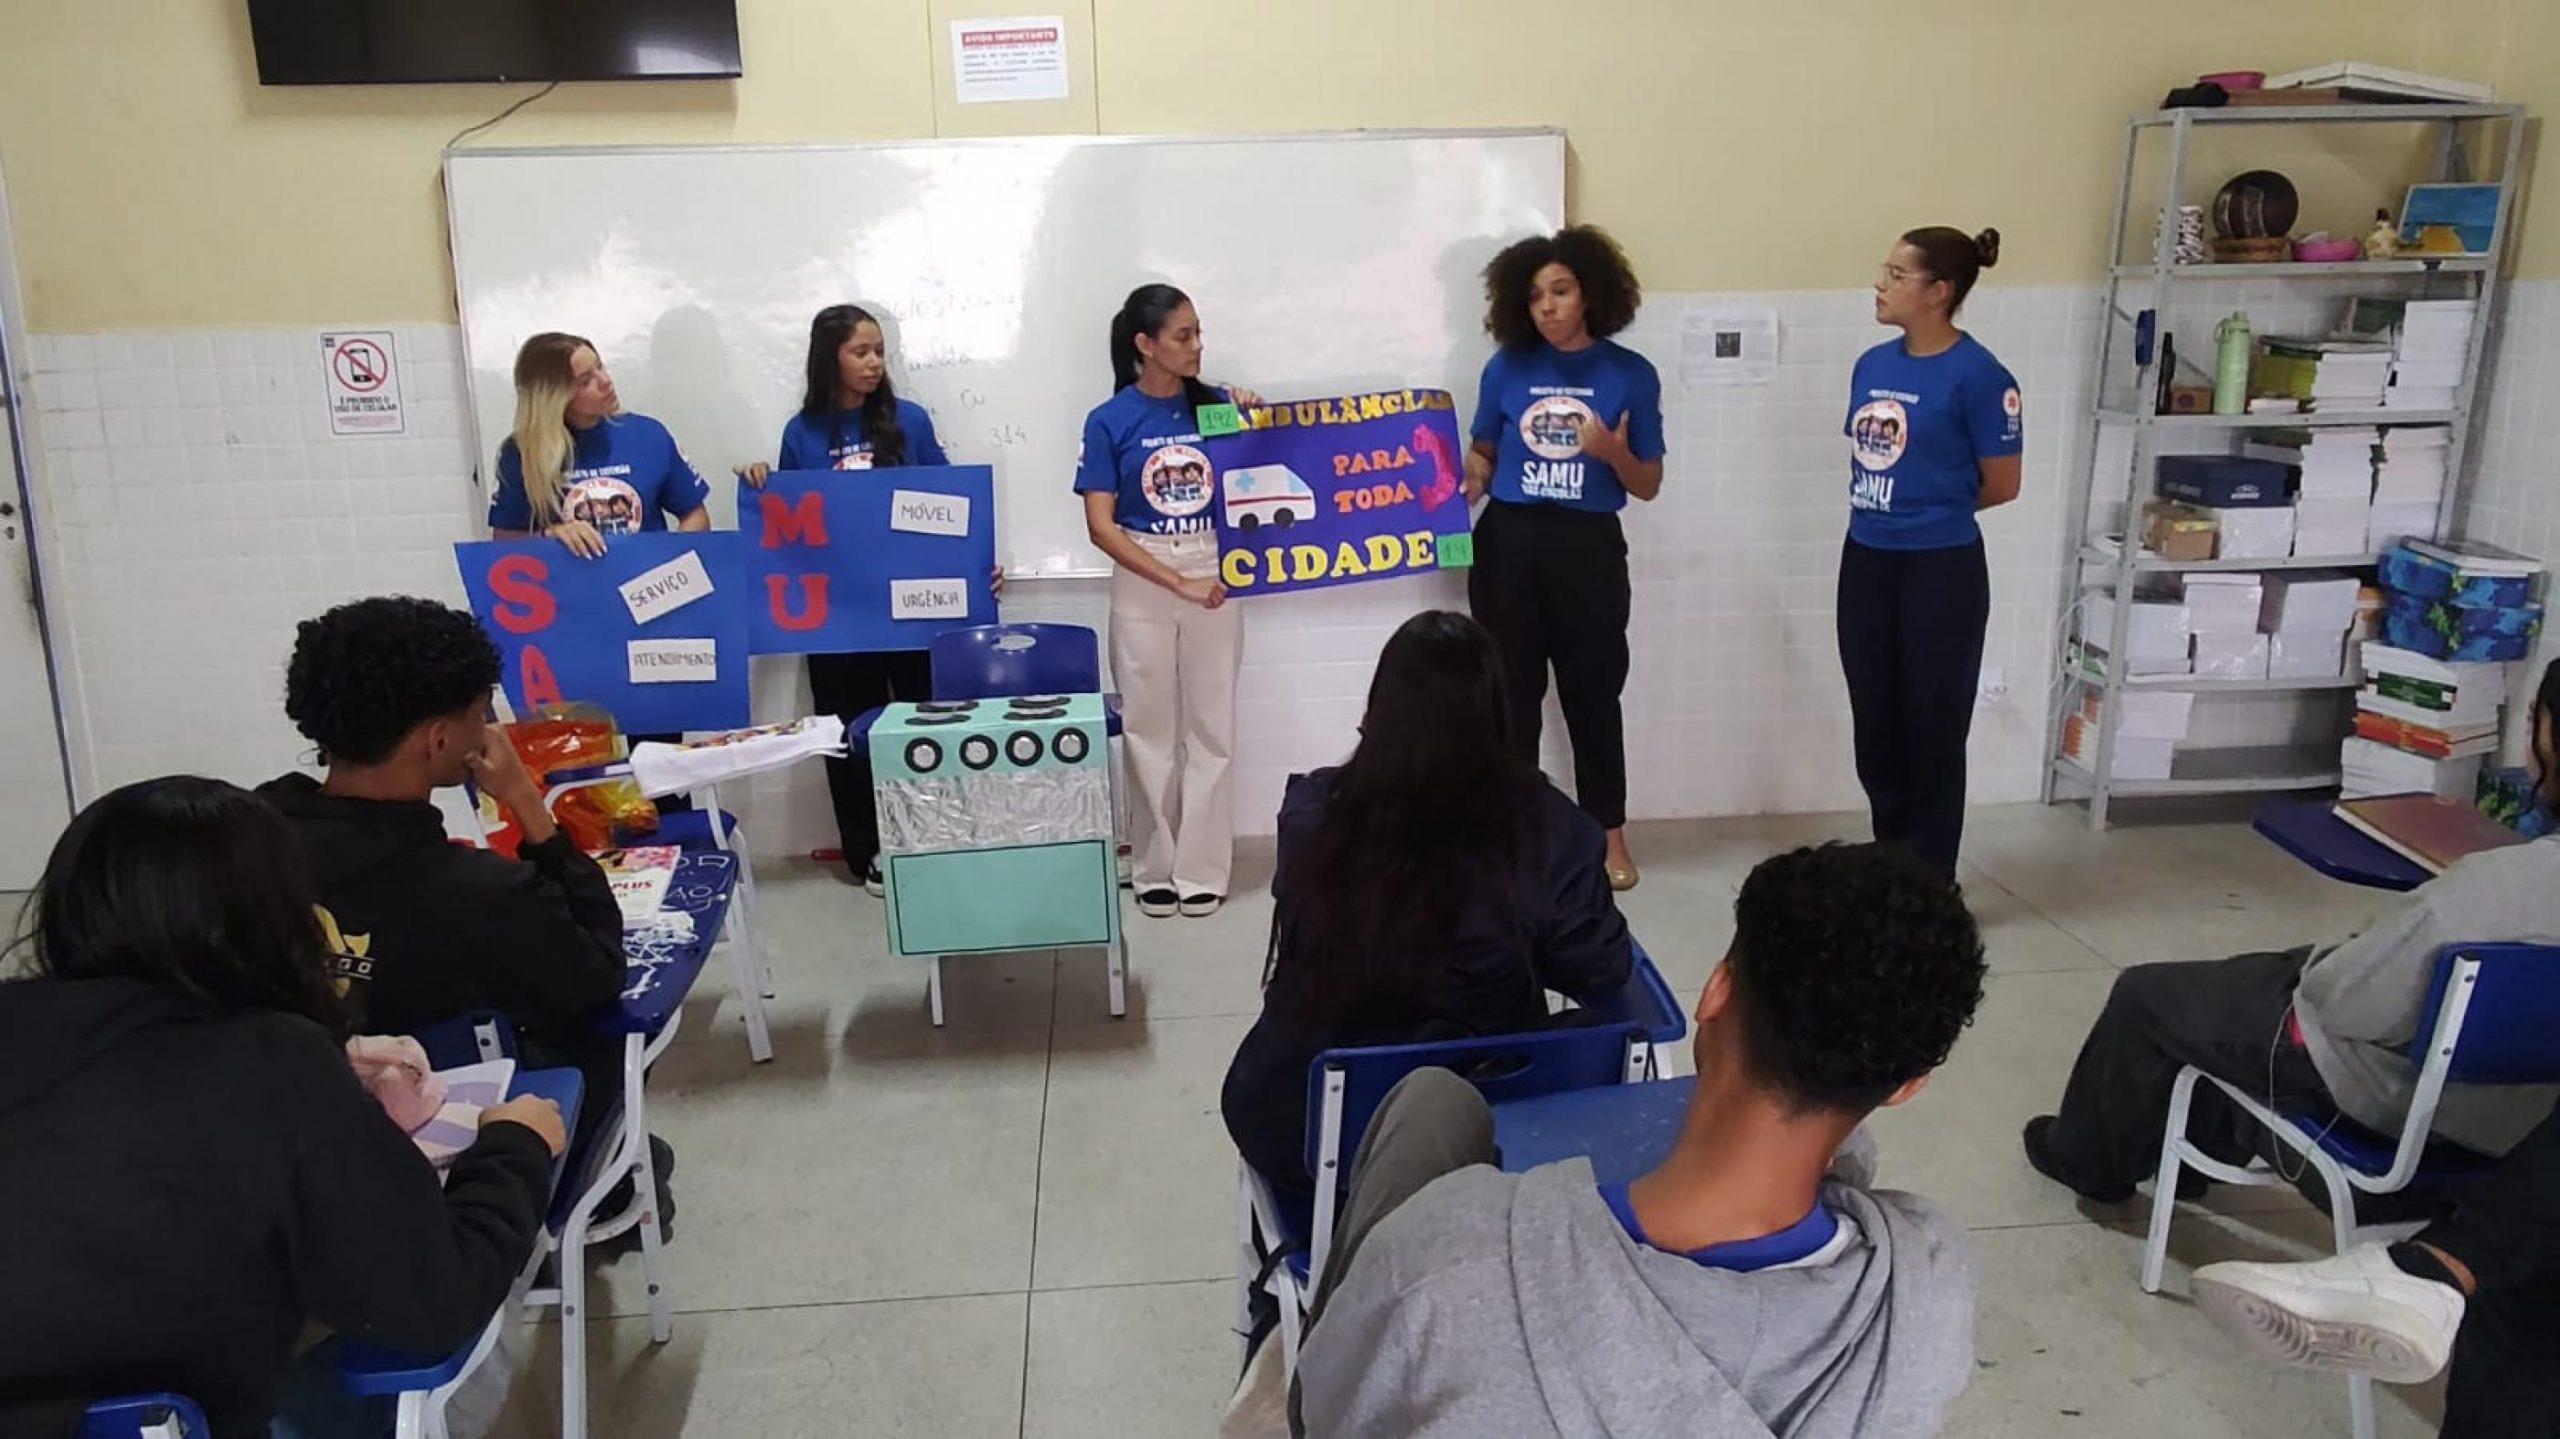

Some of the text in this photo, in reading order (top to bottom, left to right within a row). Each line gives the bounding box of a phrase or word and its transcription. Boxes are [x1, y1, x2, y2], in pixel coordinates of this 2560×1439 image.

[1205, 410, 1233, 430] 192
[1333, 445, 1416, 476] PARA
[1522, 460, 1585, 488] SAMU
[757, 489, 830, 549] M
[1333, 481, 1415, 513] TODA
[1221, 530, 1435, 587] CIDADE
[488, 553, 557, 634] S
[629, 571, 689, 608] SERVIÇO
[765, 573, 830, 632] U
[520, 644, 567, 713] A
